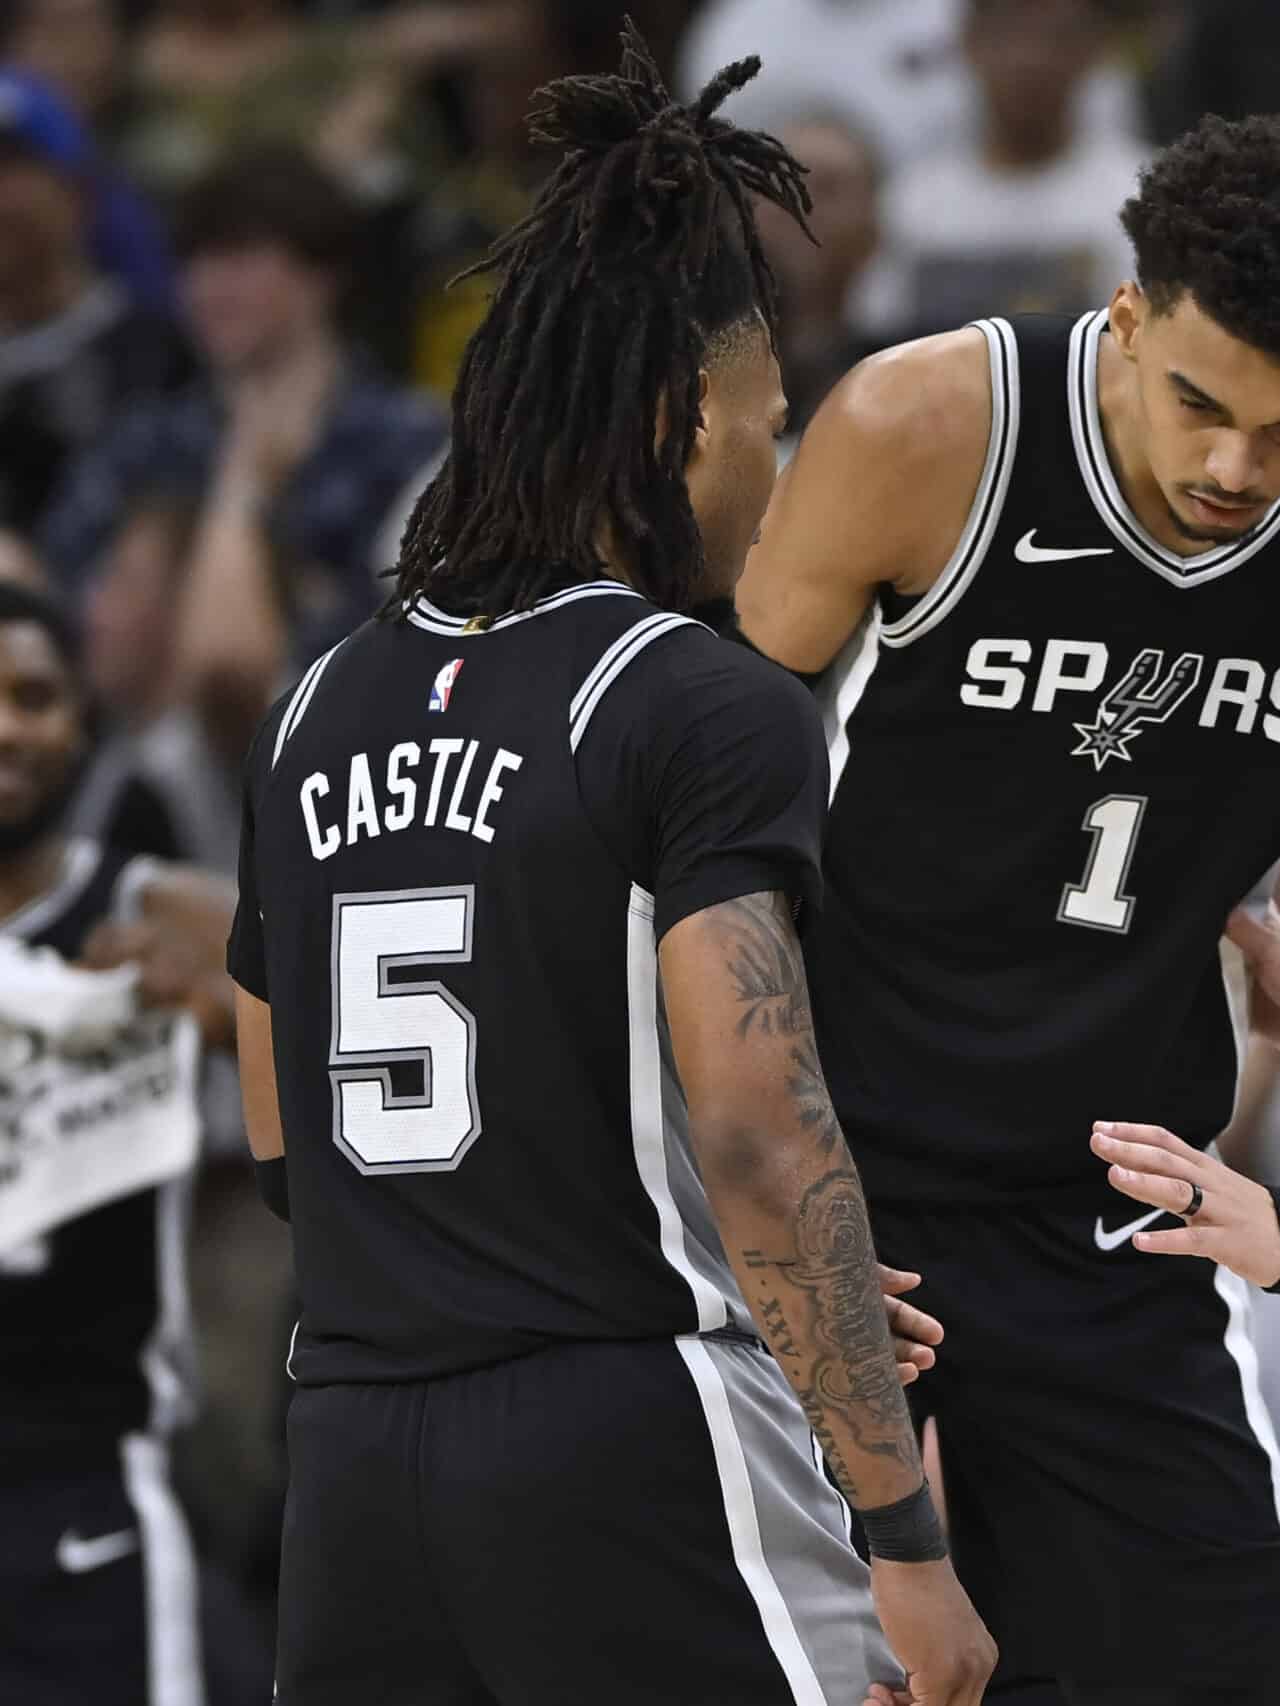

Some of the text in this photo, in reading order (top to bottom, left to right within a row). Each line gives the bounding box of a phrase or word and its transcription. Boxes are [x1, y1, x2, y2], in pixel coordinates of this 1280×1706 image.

[299, 738, 523, 861] CASTLE
[1056, 793, 1148, 935] 1
[328, 884, 482, 1175] 5
